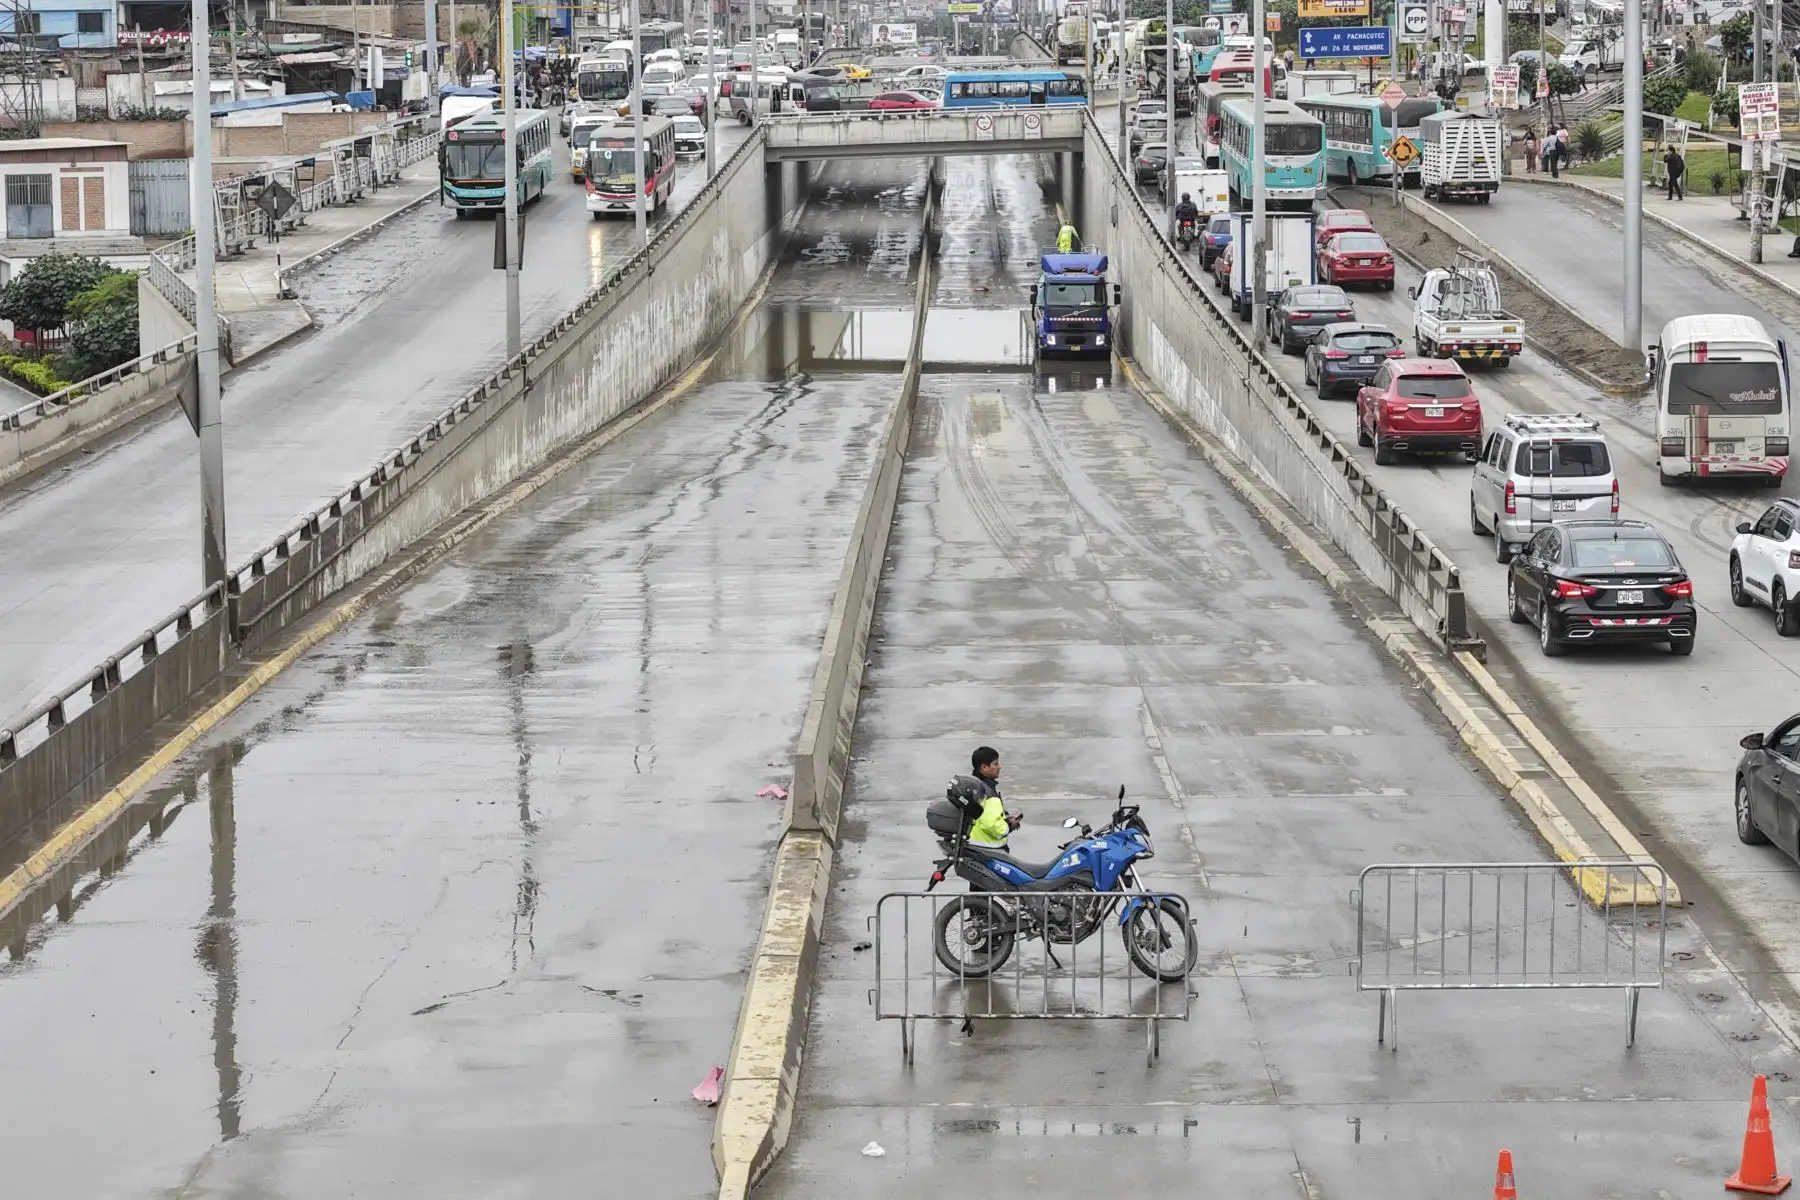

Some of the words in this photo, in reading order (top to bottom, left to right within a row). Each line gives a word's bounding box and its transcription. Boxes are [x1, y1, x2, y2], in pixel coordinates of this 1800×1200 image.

[1408, 16, 1427, 24] PPP
[1347, 32, 1385, 40] PACHACUTEC
[1028, 117, 1038, 125] 40
[604, 150, 612, 160] G
